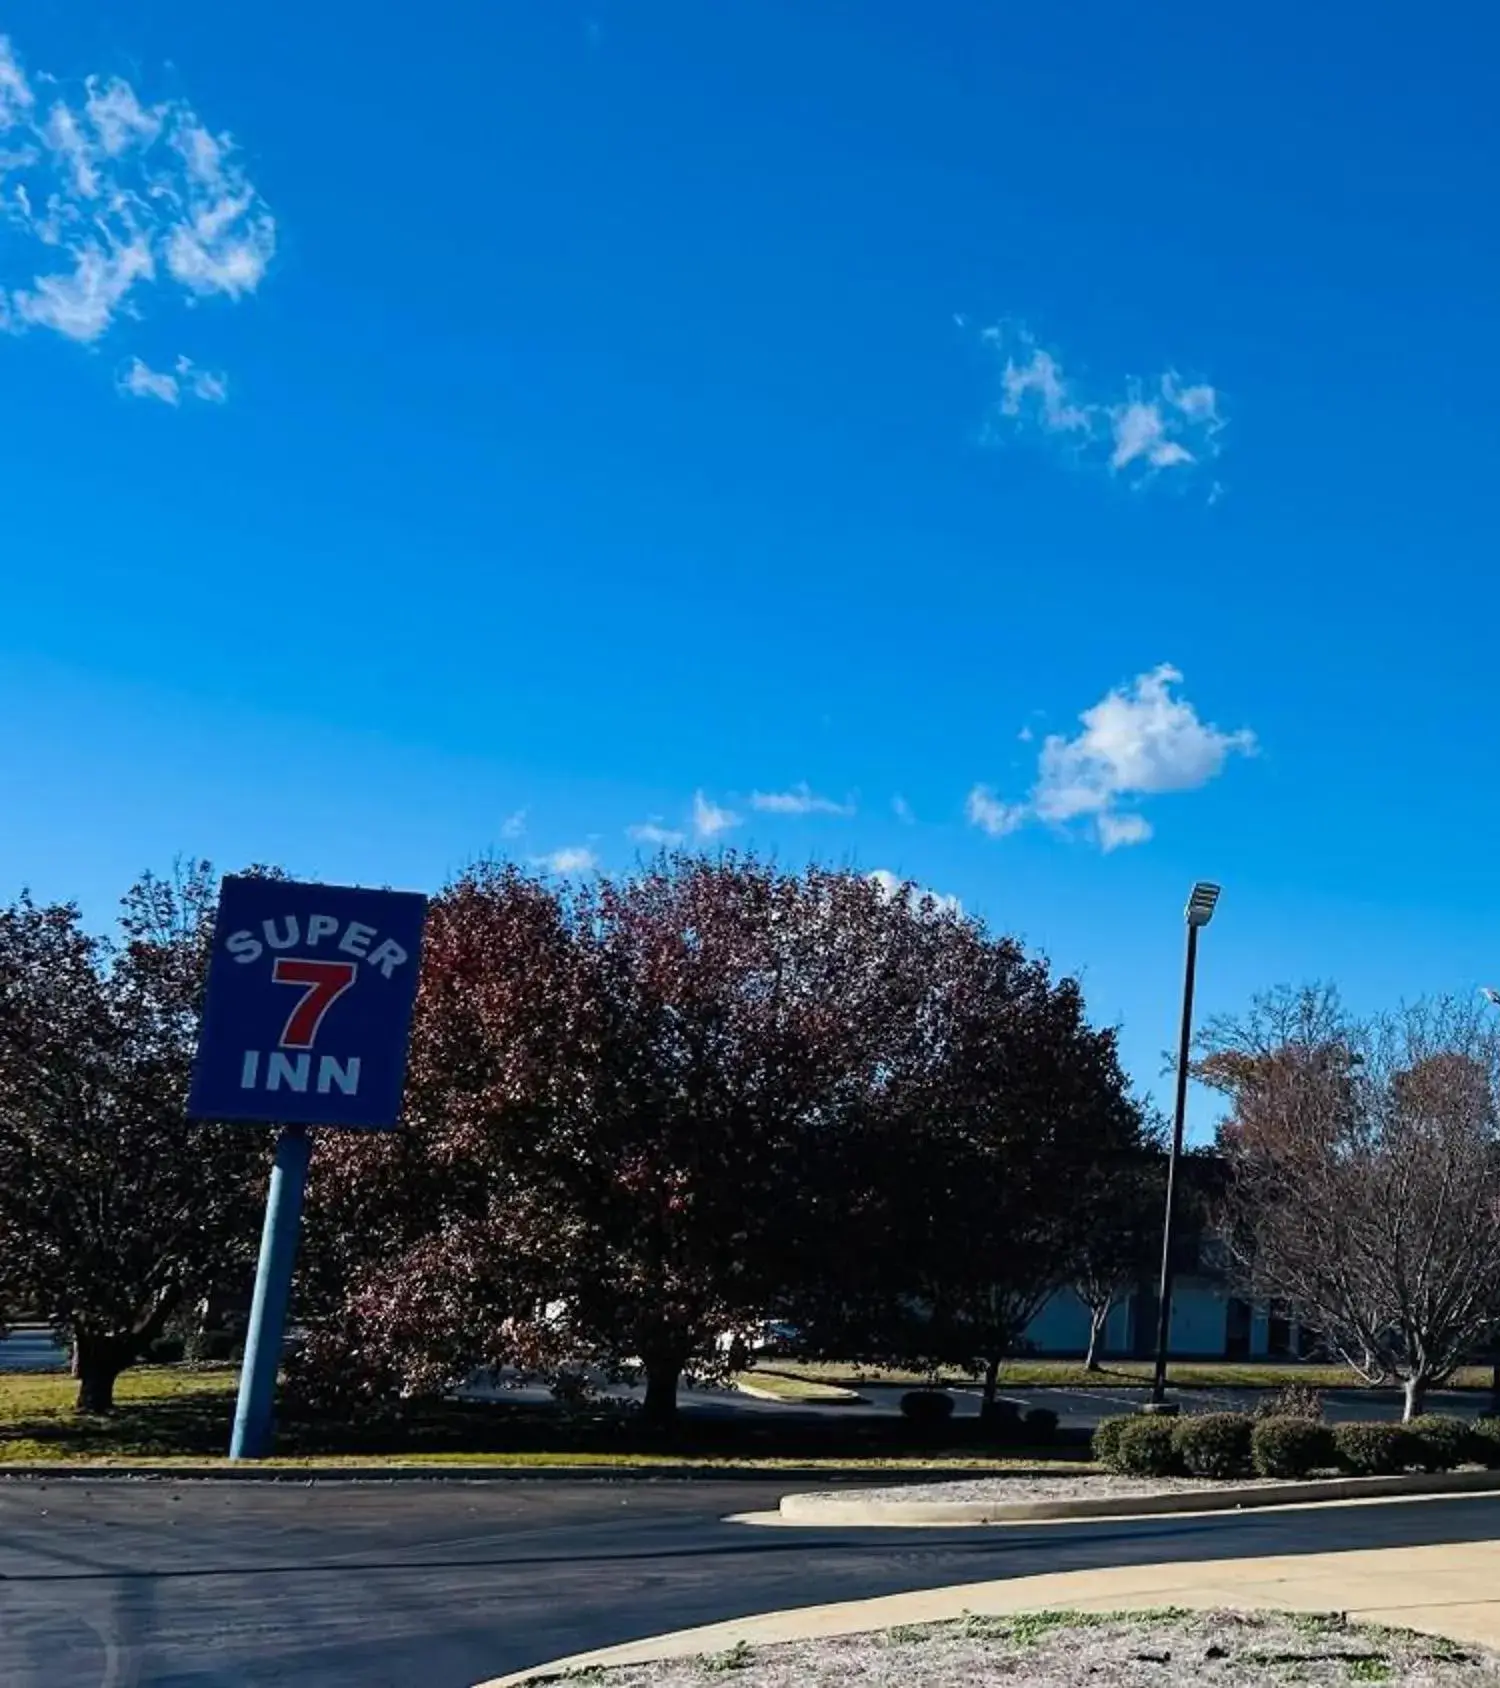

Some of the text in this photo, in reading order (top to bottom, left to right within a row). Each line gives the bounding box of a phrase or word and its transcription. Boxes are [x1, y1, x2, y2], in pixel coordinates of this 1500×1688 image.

[224, 913, 409, 980] SUPER
[271, 956, 358, 1049] 7
[240, 1049, 361, 1096] INN
